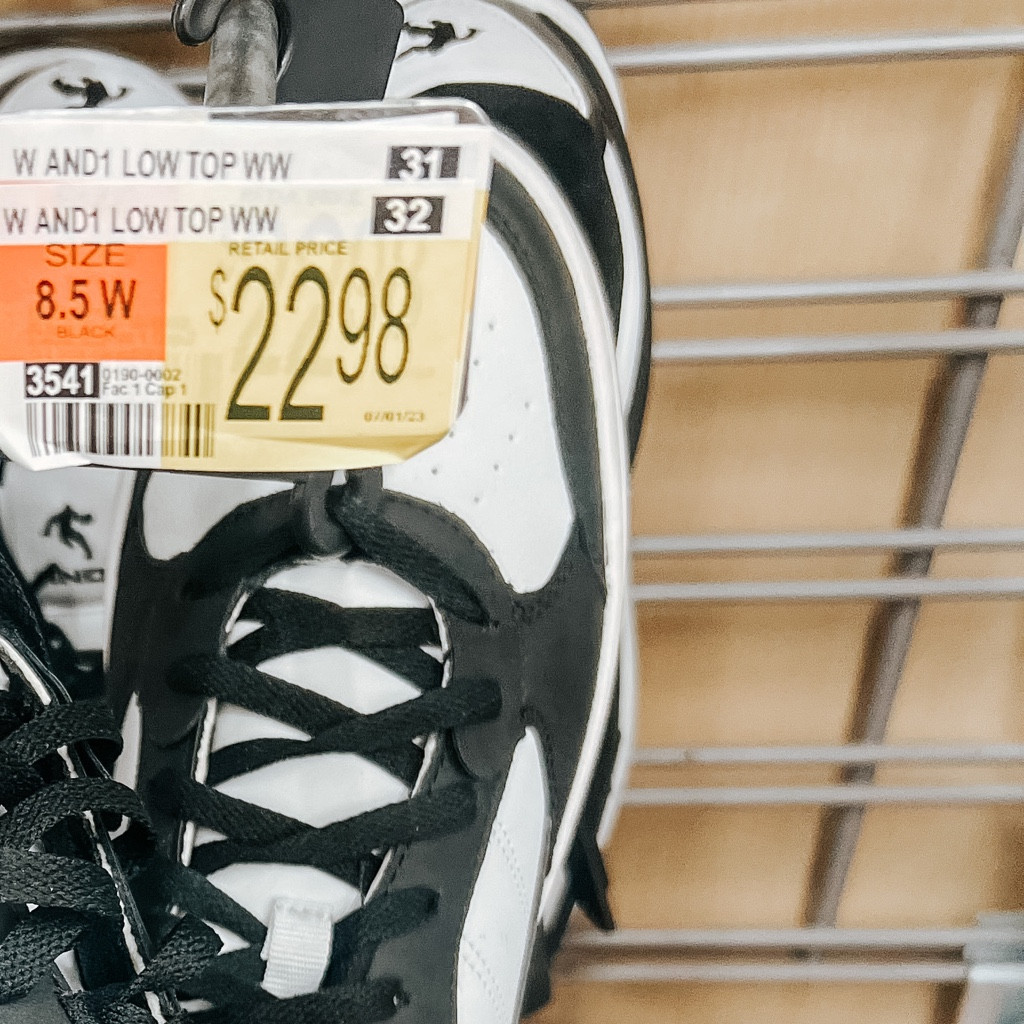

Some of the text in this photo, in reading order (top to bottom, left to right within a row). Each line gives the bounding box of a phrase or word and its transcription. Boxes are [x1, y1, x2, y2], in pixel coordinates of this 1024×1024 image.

[13, 148, 292, 180] W AND1 LOW TOP WW
[398, 147, 443, 180] 31
[3, 207, 279, 234] W AND1 LOW TOP WW
[384, 198, 433, 232] 32
[45, 243, 126, 267] SIZE
[228, 242, 348, 256] RETAIL PRICE
[36, 280, 136, 320] 8.5 W
[56, 325, 116, 339] BLACK
[26, 363, 96, 396] 3541
[102, 384, 128, 396] Fac
[145, 384, 176, 399] Cap
